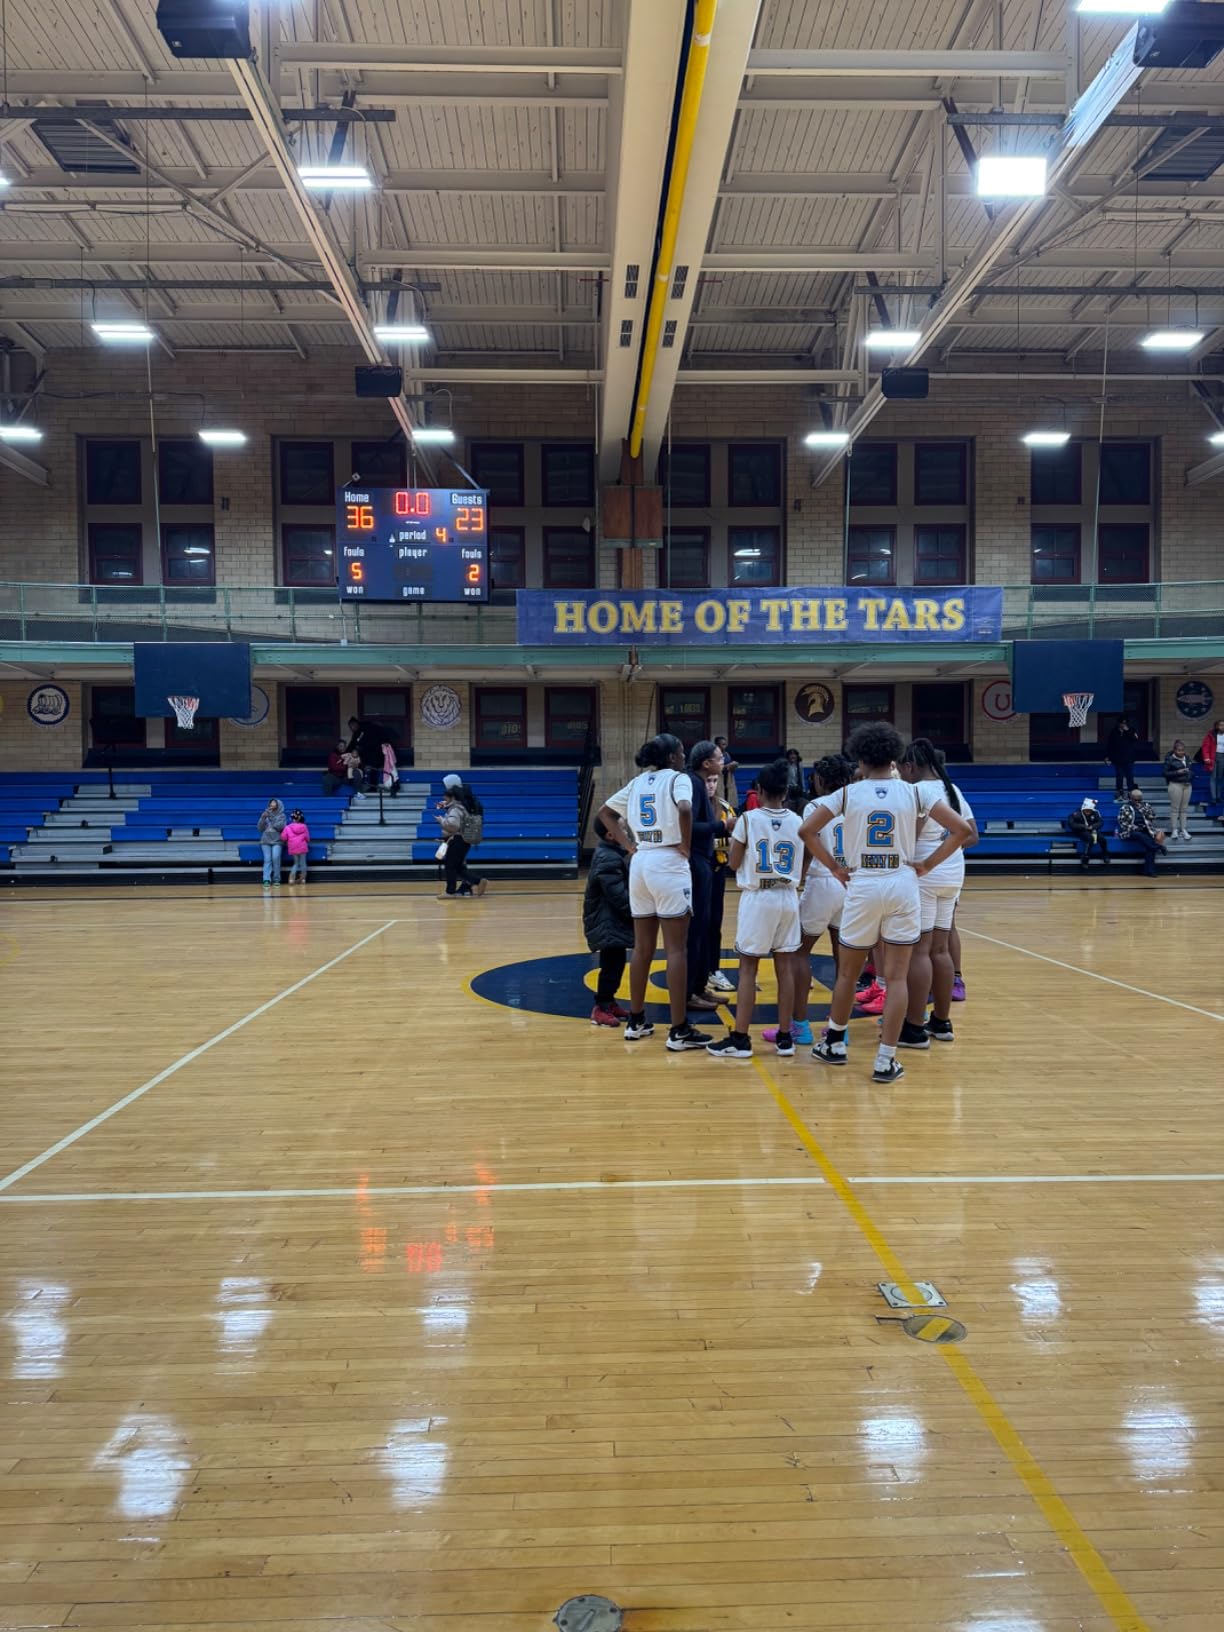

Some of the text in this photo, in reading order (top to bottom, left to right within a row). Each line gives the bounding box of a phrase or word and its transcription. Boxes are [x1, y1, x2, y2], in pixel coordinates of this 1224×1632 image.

[344, 491, 369, 503] Home
[395, 491, 430, 515] 0.0
[451, 492, 482, 505] Guests
[346, 505, 374, 529] 36
[455, 507, 484, 531] 23
[399, 527, 447, 543] period 4
[398, 546, 428, 558] player
[351, 562, 363, 580] 5
[468, 563, 480, 582] 2
[347, 586, 363, 594] won
[403, 586, 425, 596] game
[464, 587, 481, 596] won
[553, 598, 965, 634] HOME OF THE TARS
[639, 794, 657, 827] 5
[867, 810, 895, 847] 2
[755, 838, 795, 874] 13
